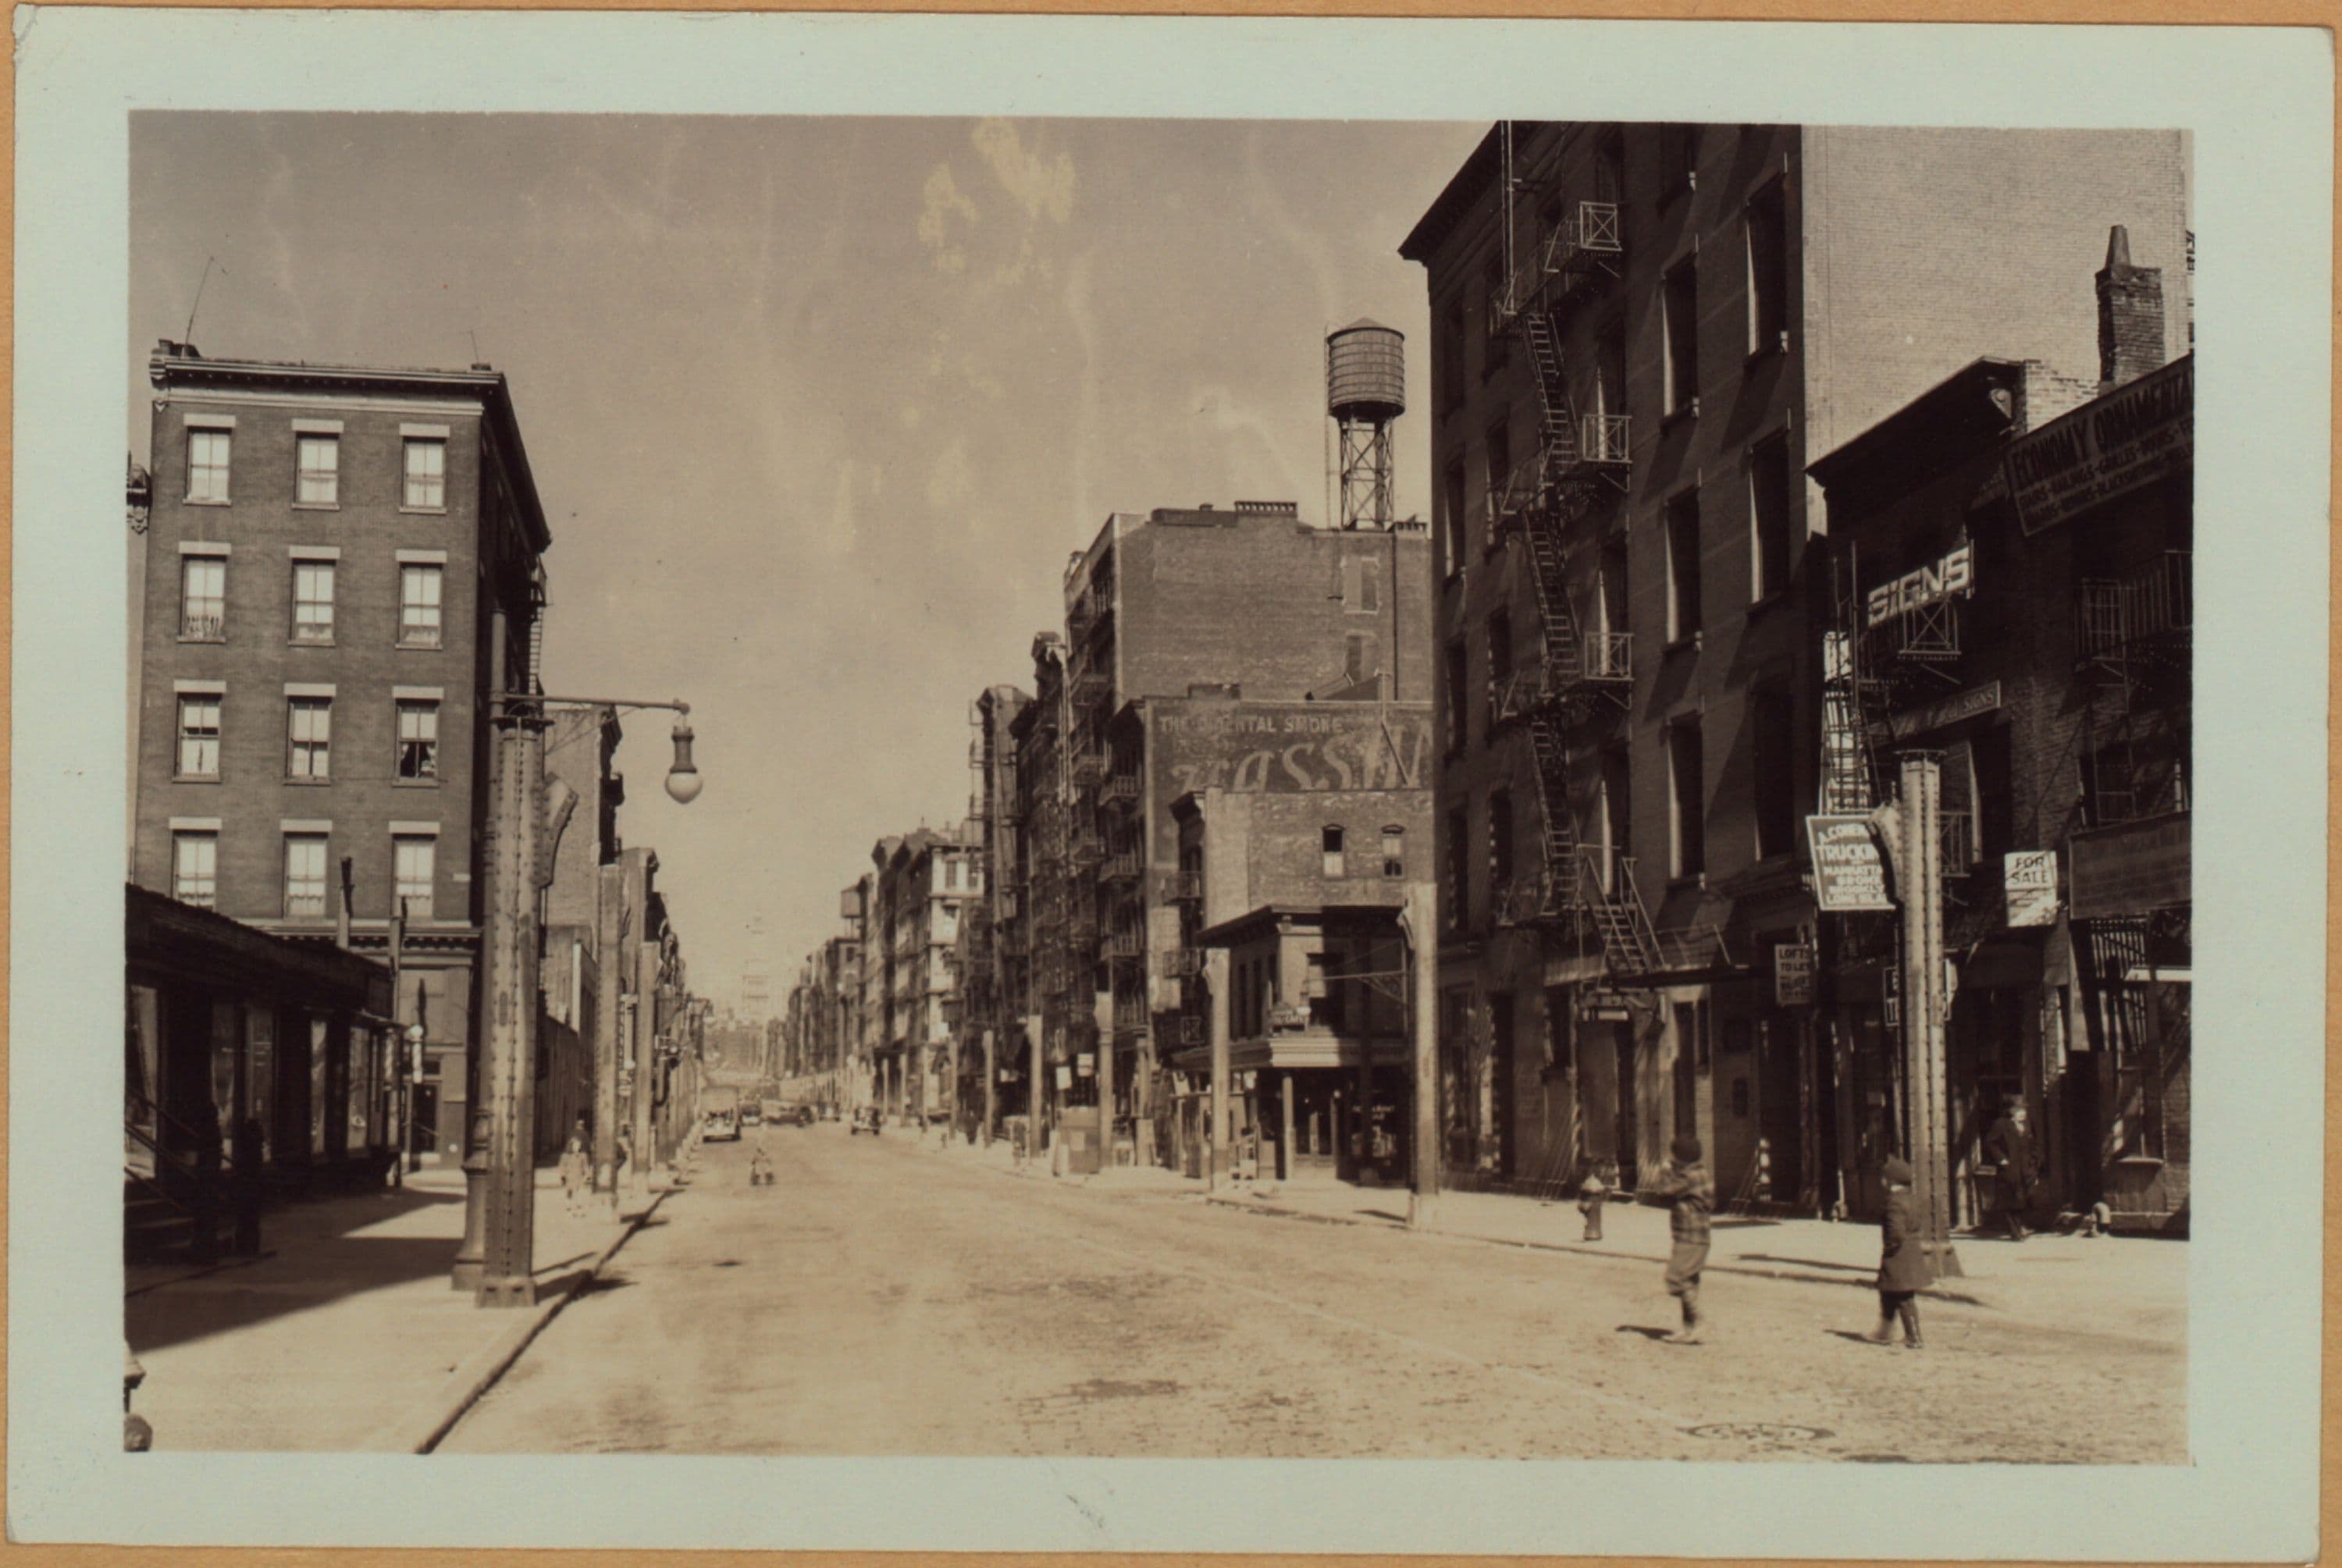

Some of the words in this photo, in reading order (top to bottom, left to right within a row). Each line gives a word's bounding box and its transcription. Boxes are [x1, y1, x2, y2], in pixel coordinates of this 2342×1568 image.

[2012, 418, 2088, 492] ECONOMY
[2094, 368, 2193, 454] ORNAMENTA
[1963, 691, 1995, 712] SIGNS
[1283, 714, 1344, 733] SMOKE
[1816, 844, 1881, 862] TRUCKIN
[2016, 856, 2045, 868] FOR
[1823, 865, 1883, 876] MANHATTA
[2011, 870, 2048, 884] SALE
[1829, 885, 1885, 895] BROOKLY
